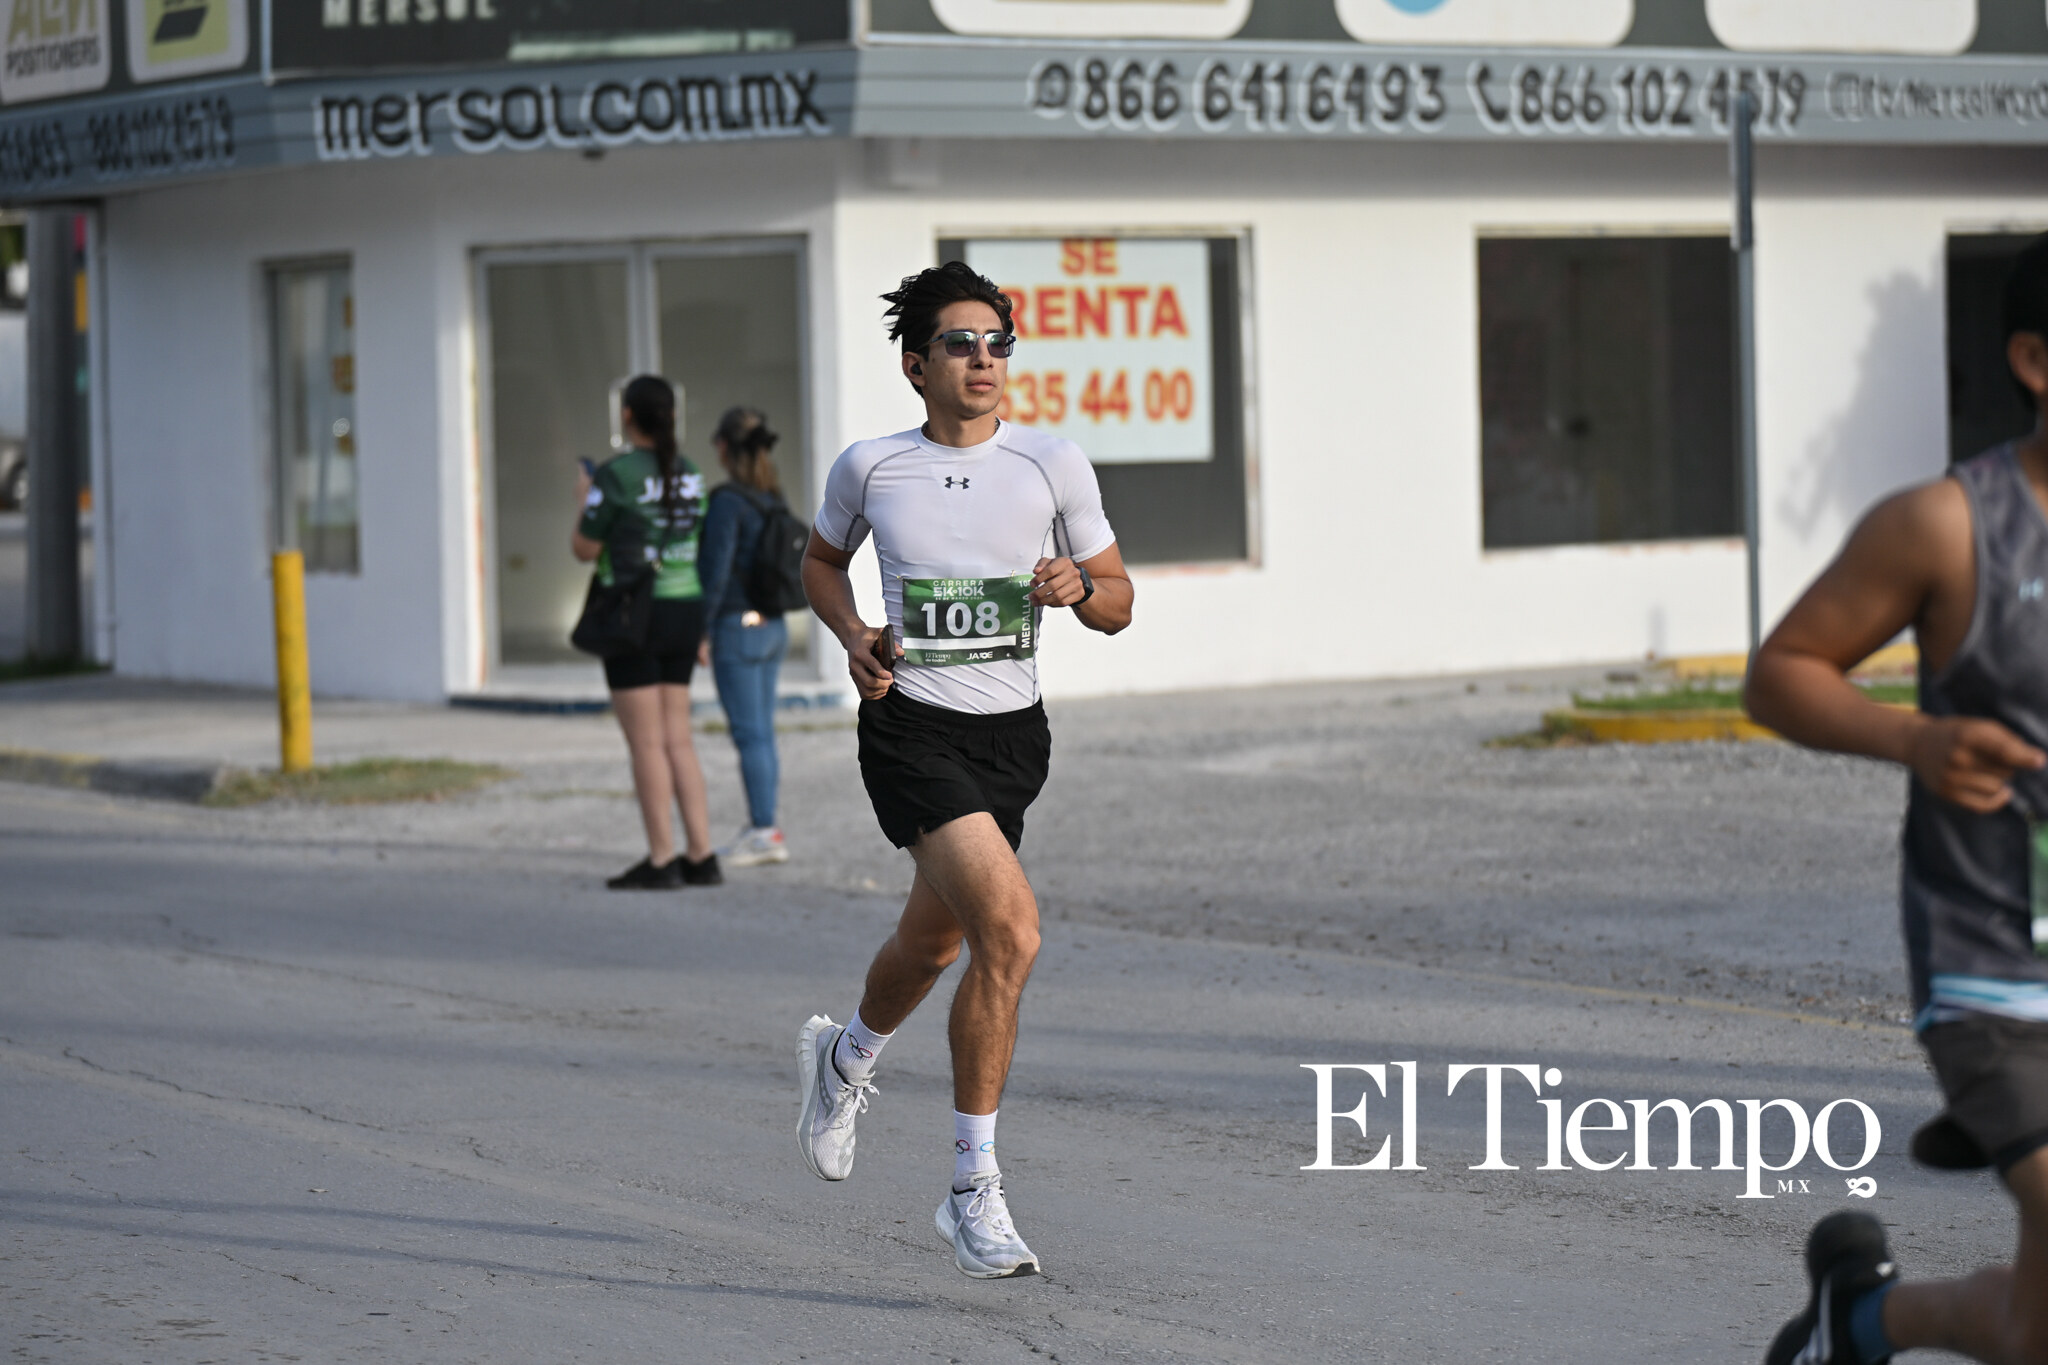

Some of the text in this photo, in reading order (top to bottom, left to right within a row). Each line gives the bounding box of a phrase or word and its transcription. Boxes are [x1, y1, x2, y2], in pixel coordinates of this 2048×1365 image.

[1082, 58, 1448, 124] 866 641 6493
[1518, 66, 1606, 124] 866
[1621, 68, 1694, 124] 102
[1062, 237, 1117, 276] SE
[999, 285, 1188, 339] RENTA
[1080, 370, 1131, 421] 44
[1144, 370, 1193, 421] 00
[921, 601, 1001, 637] 108
[1021, 593, 1031, 649] MEDALLA
